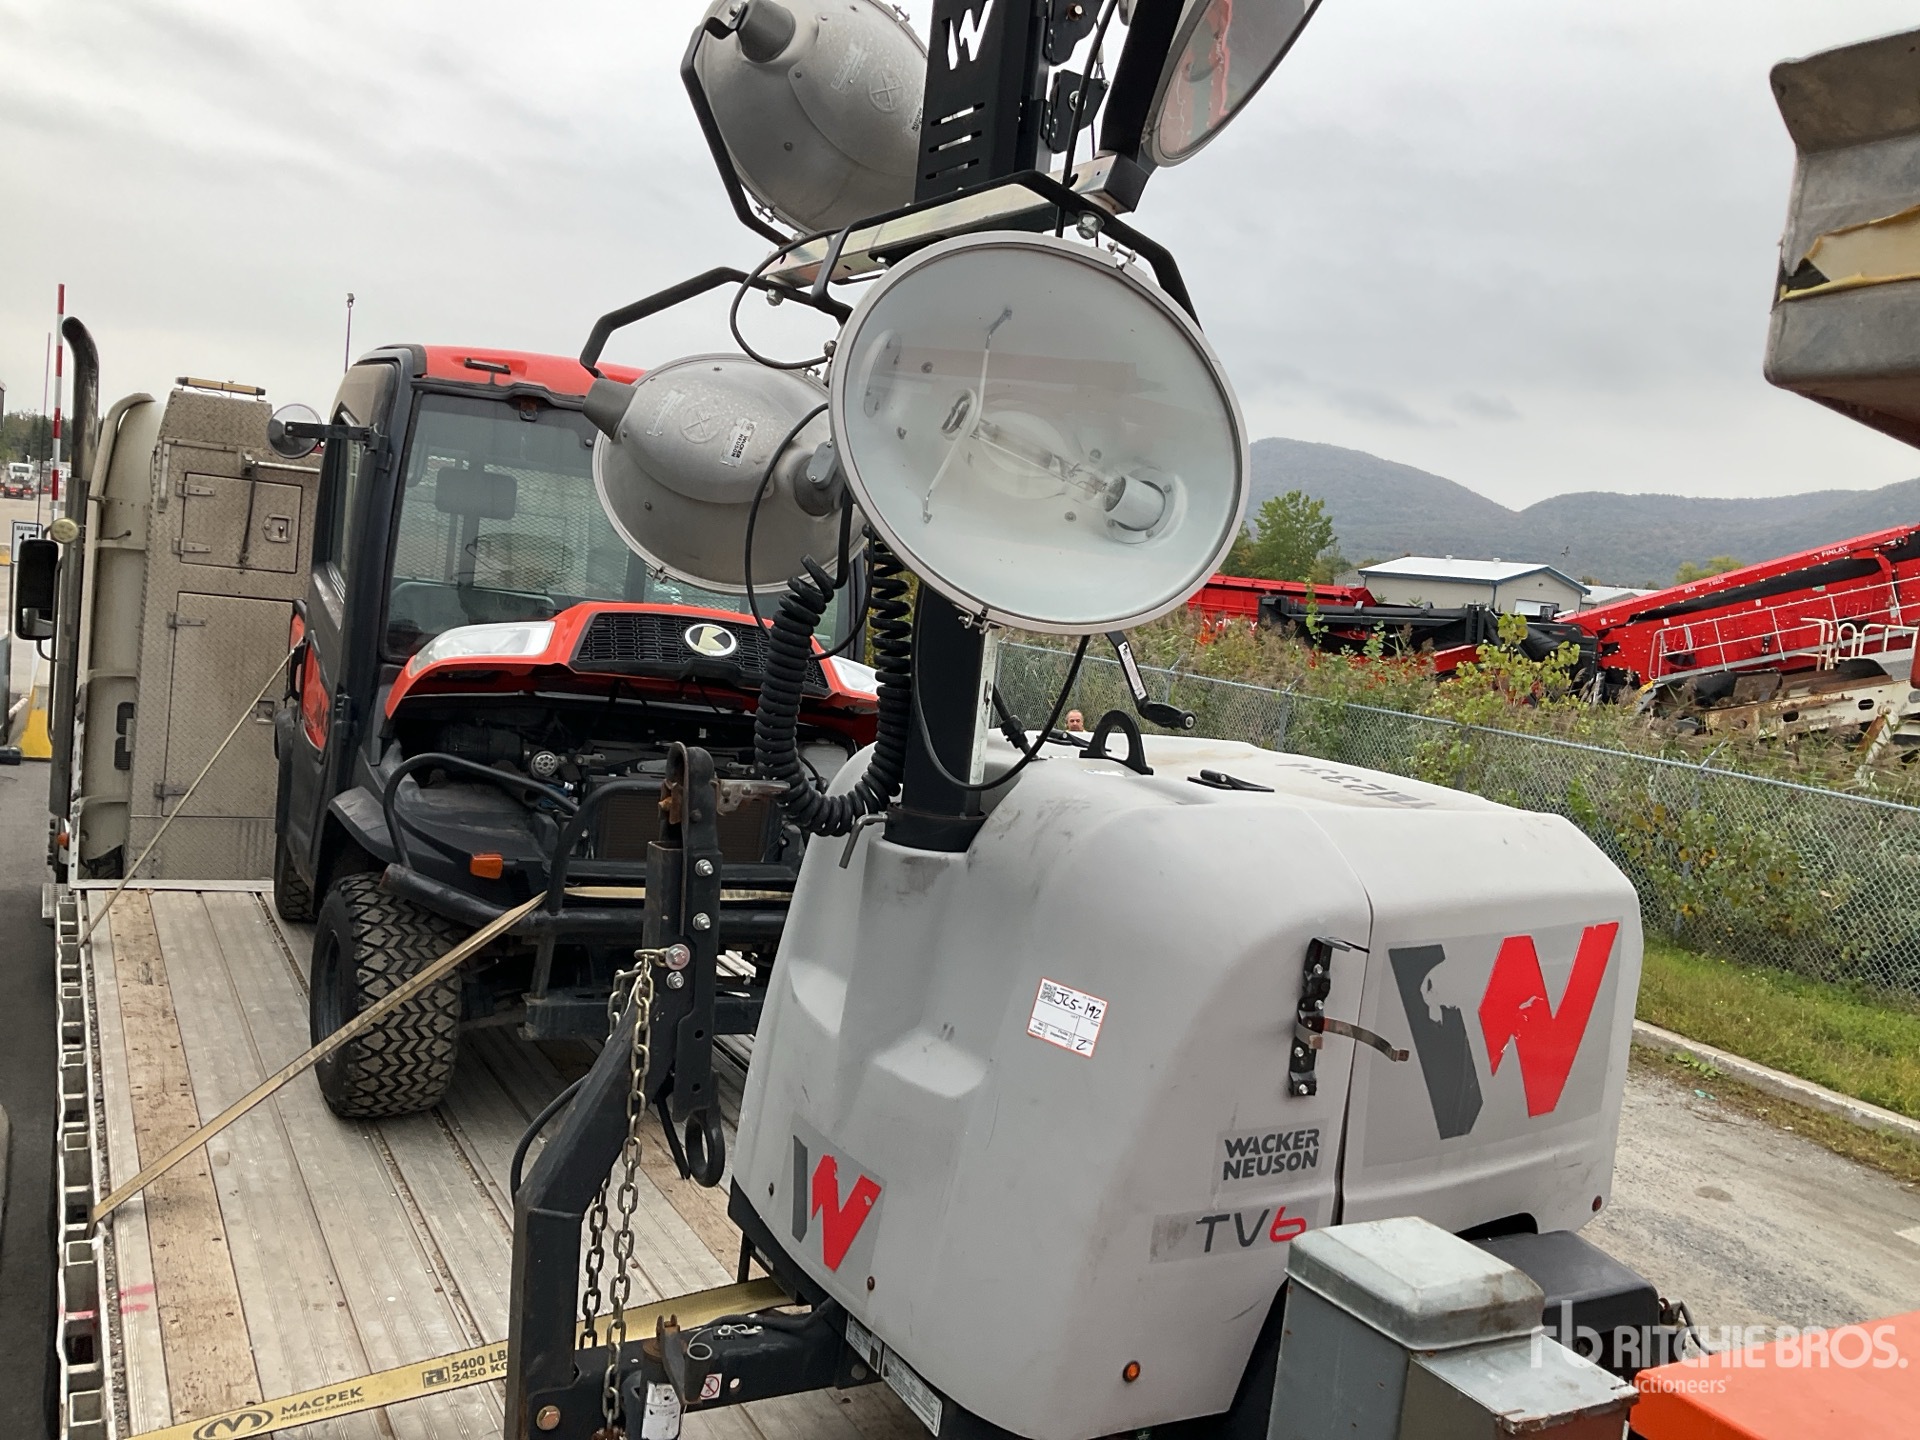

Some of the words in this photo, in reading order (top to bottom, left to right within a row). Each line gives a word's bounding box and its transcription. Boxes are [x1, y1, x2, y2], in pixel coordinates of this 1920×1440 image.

[1821, 545, 1848, 557] FINLAY
[1224, 1128, 1320, 1159] WACKER
[1223, 1149, 1319, 1181] NEUSON
[1196, 1206, 1307, 1253] TV6
[451, 1355, 485, 1373] 5400
[452, 1367, 487, 1383] 2450
[281, 1386, 364, 1415] MACPEK
